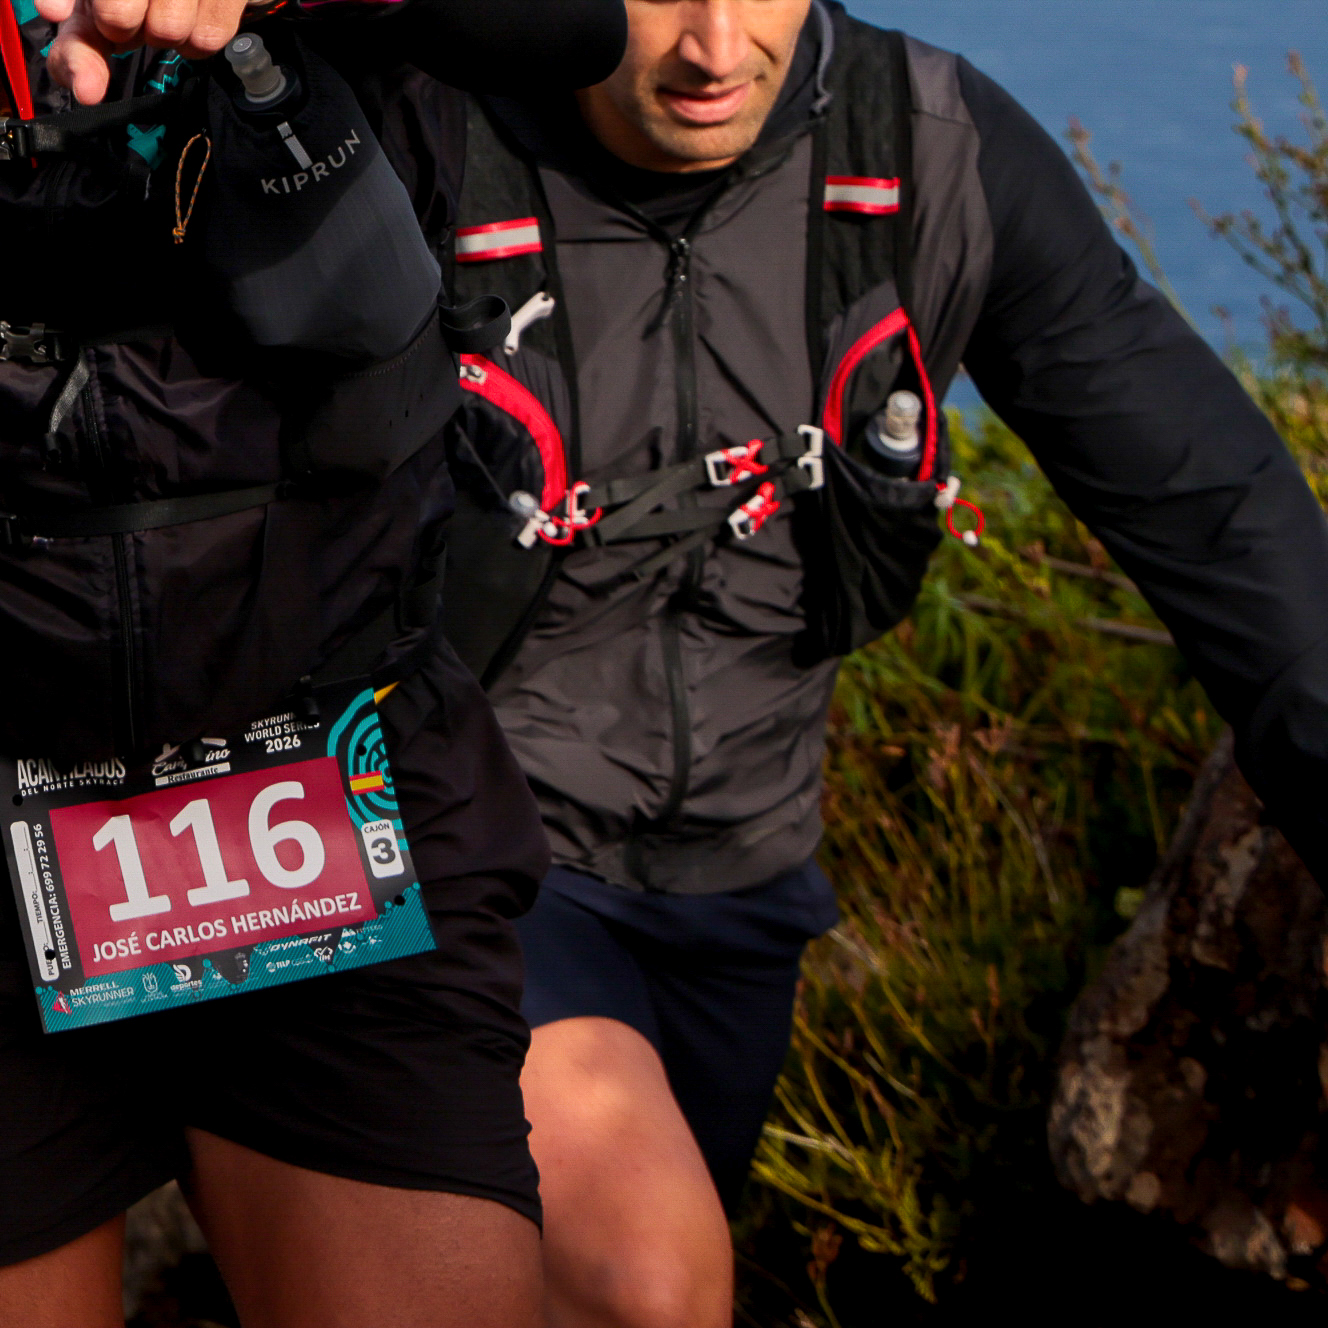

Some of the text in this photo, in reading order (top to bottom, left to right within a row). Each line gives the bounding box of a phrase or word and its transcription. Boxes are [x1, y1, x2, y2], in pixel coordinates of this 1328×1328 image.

[260, 129, 361, 194] KIPRUN
[244, 725, 282, 743] WORLD
[265, 734, 301, 753] 2026
[167, 767, 219, 783] Restaurante
[21, 778, 125, 797] DEL NORTE SKYRACE
[364, 822, 391, 834] CAJÓN
[91, 780, 325, 922] 116
[371, 837, 395, 863] 3
[33, 824, 72, 969] EMERGENCIA: 699 72 29 56
[32, 891, 43, 924] TIEMPO:
[93, 891, 362, 963] JOSÉ CARLOS HERNÁNDEZ
[270, 933, 332, 952] DYNAFIT
[69, 980, 119, 997] MERRELL
[170, 979, 203, 991] deportes
[71, 986, 135, 1008] SKYRUNNER
